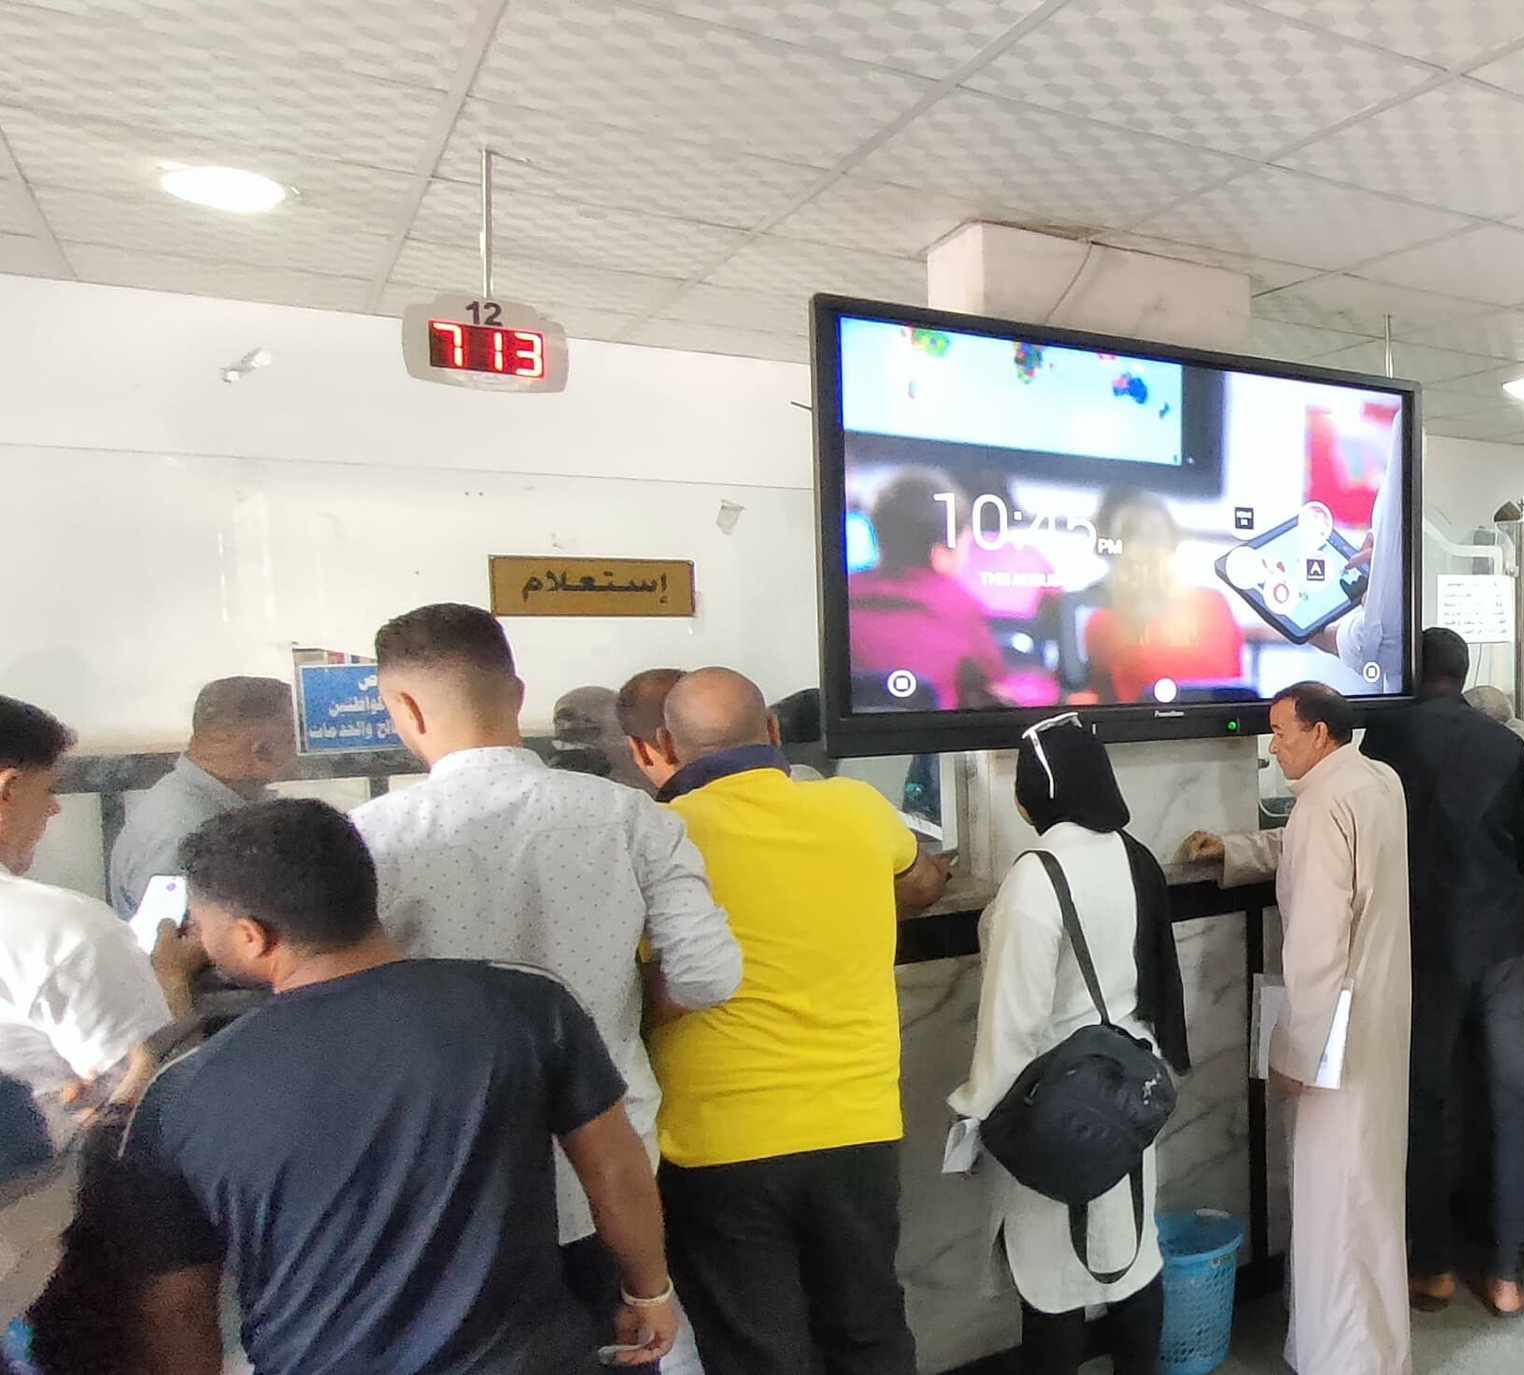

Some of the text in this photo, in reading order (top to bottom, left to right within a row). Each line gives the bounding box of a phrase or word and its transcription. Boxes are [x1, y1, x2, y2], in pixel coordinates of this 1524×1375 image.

[465, 301, 504, 327] 12
[432, 322, 544, 377] 713
[1098, 538, 1122, 556] PM
[521, 569, 669, 604] إستعلام
